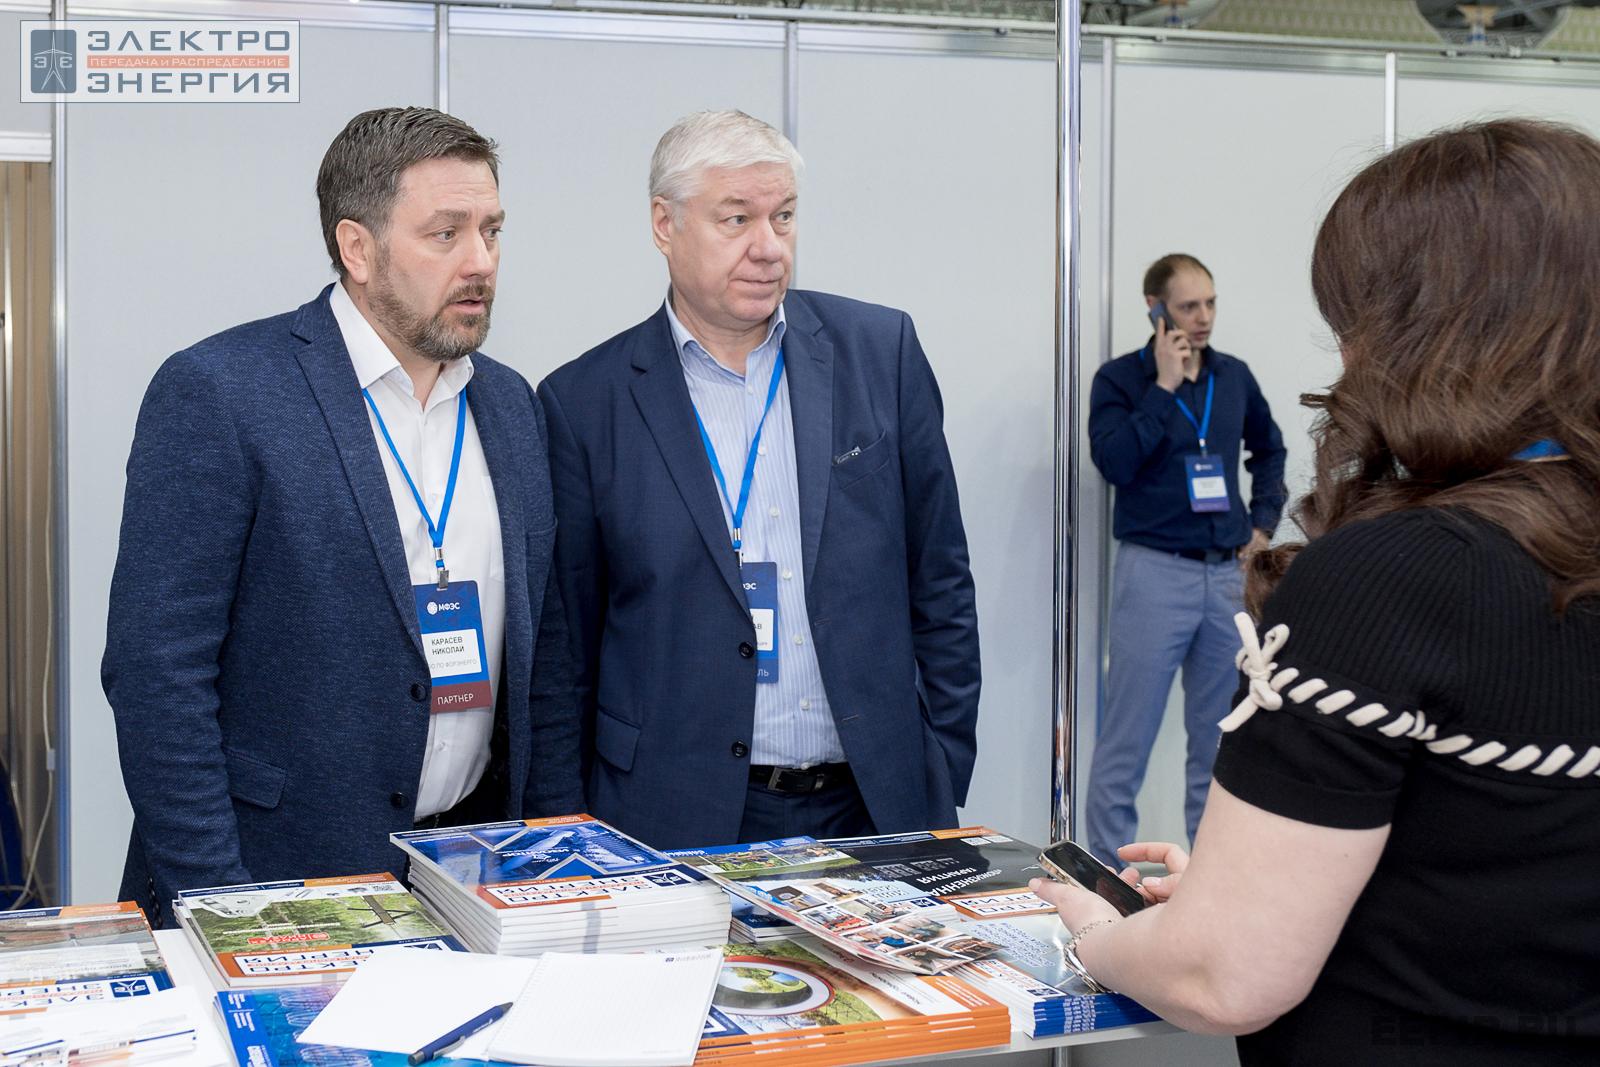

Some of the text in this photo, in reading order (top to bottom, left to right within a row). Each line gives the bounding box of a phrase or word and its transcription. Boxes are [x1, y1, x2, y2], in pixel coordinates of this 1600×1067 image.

[431, 636, 463, 646] КАРАСЕВ
[432, 646, 465, 656] НИКОЛАЙ
[437, 693, 474, 705] ПАРТНЕР
[927, 868, 1003, 897] ПОЖИЗНЕННА
[250, 959, 366, 973] ЕКТРО
[0, 983, 102, 996] ЭНЕР
[0, 994, 104, 1009] ЭЛЕК
